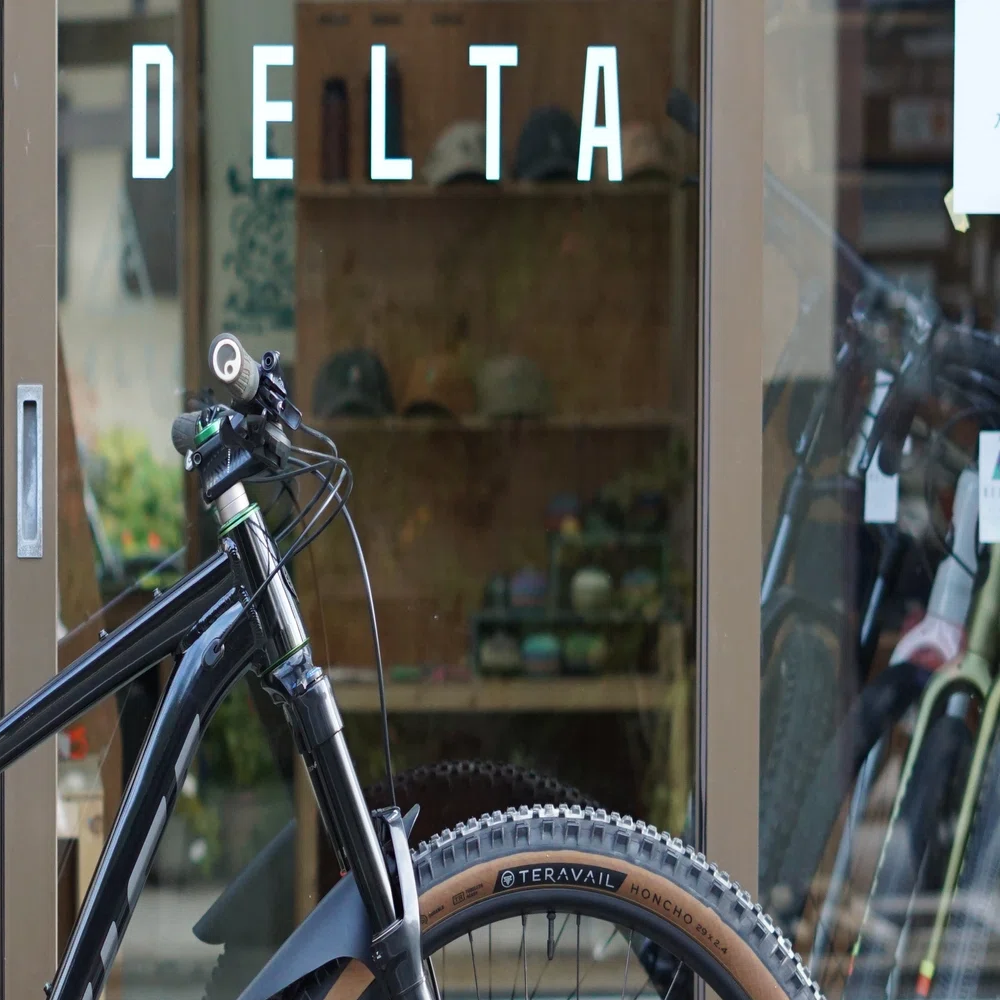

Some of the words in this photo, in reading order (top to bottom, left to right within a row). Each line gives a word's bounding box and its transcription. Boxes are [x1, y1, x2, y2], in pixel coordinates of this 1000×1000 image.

[131, 44, 623, 182] DELTA
[518, 867, 615, 889] TERAVAIL
[630, 883, 693, 925] HONCHO
